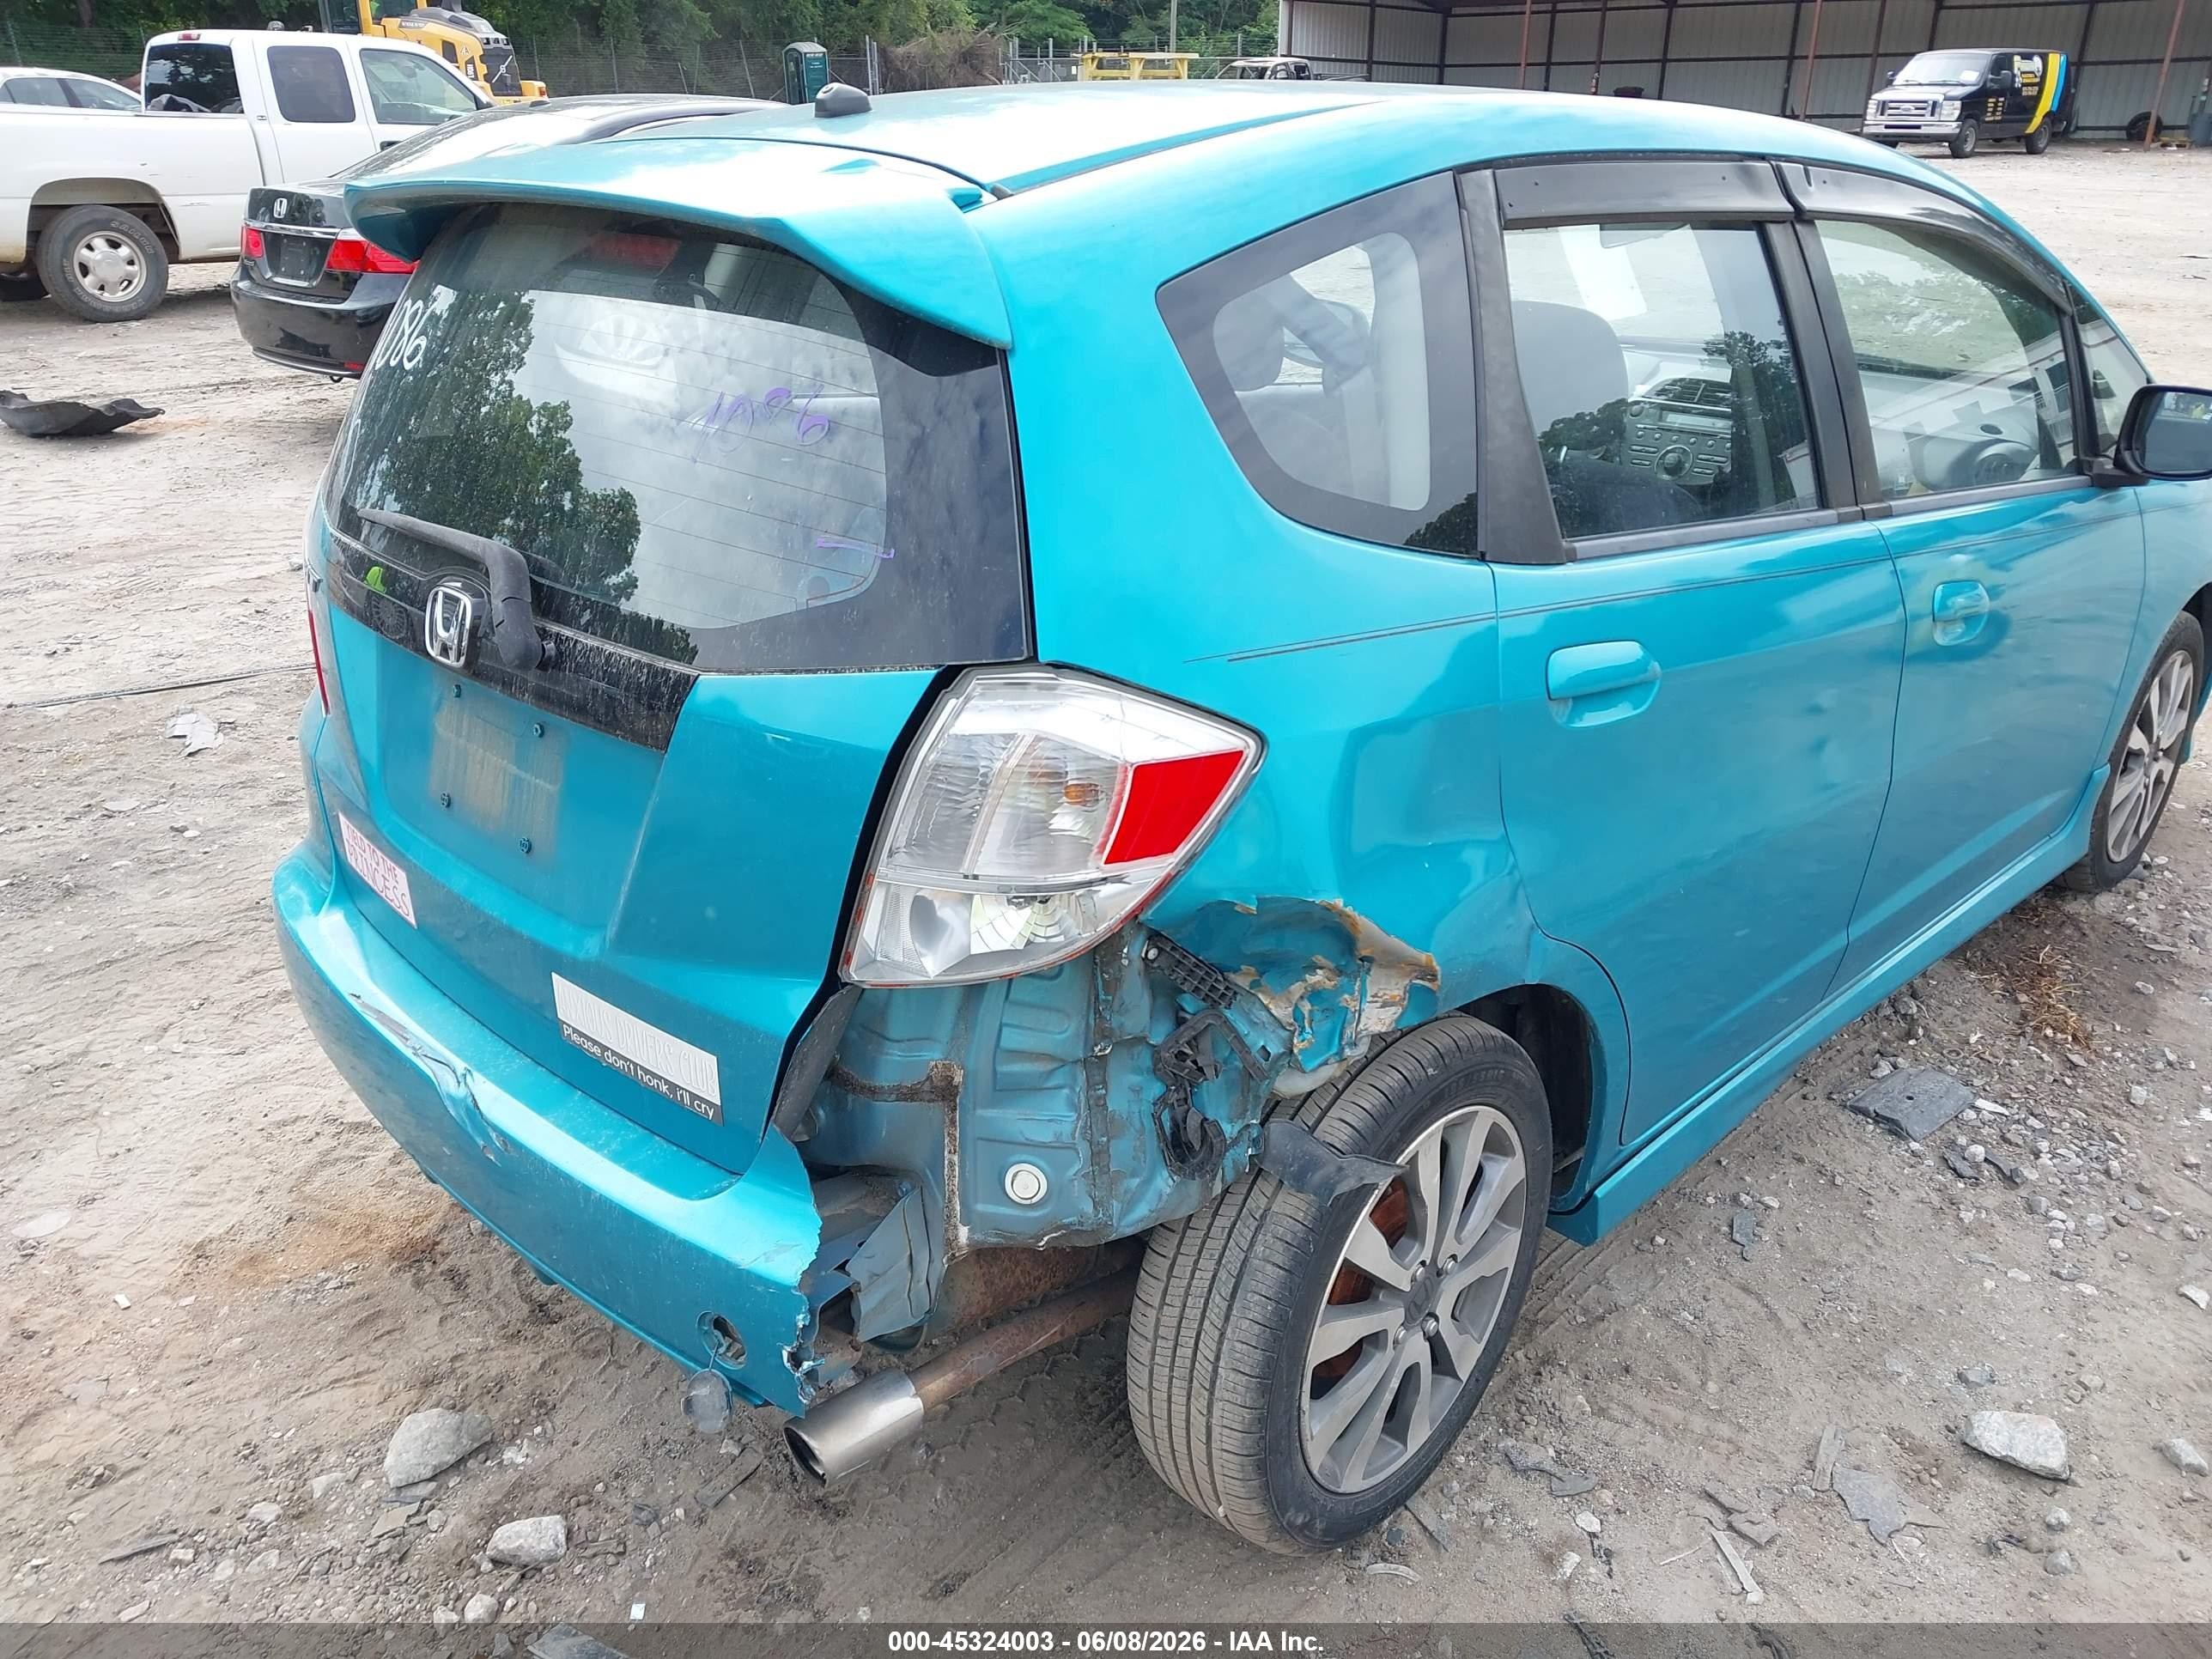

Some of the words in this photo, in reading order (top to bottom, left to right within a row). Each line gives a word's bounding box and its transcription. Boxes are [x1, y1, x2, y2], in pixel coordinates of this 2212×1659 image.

[690, 384, 830, 464] 1086
[346, 837, 410, 917] PRINCESS
[367, 842, 380, 867] TO
[380, 855, 398, 884] THE
[558, 985, 614, 1043] ANXIOUS
[615, 1017, 674, 1078] DRIVERS
[679, 1049, 718, 1097] CLUB
[562, 1024, 602, 1057] Please
[604, 1049, 635, 1077] don't
[637, 1065, 673, 1099] honk,
[694, 1100, 714, 1121] cry
